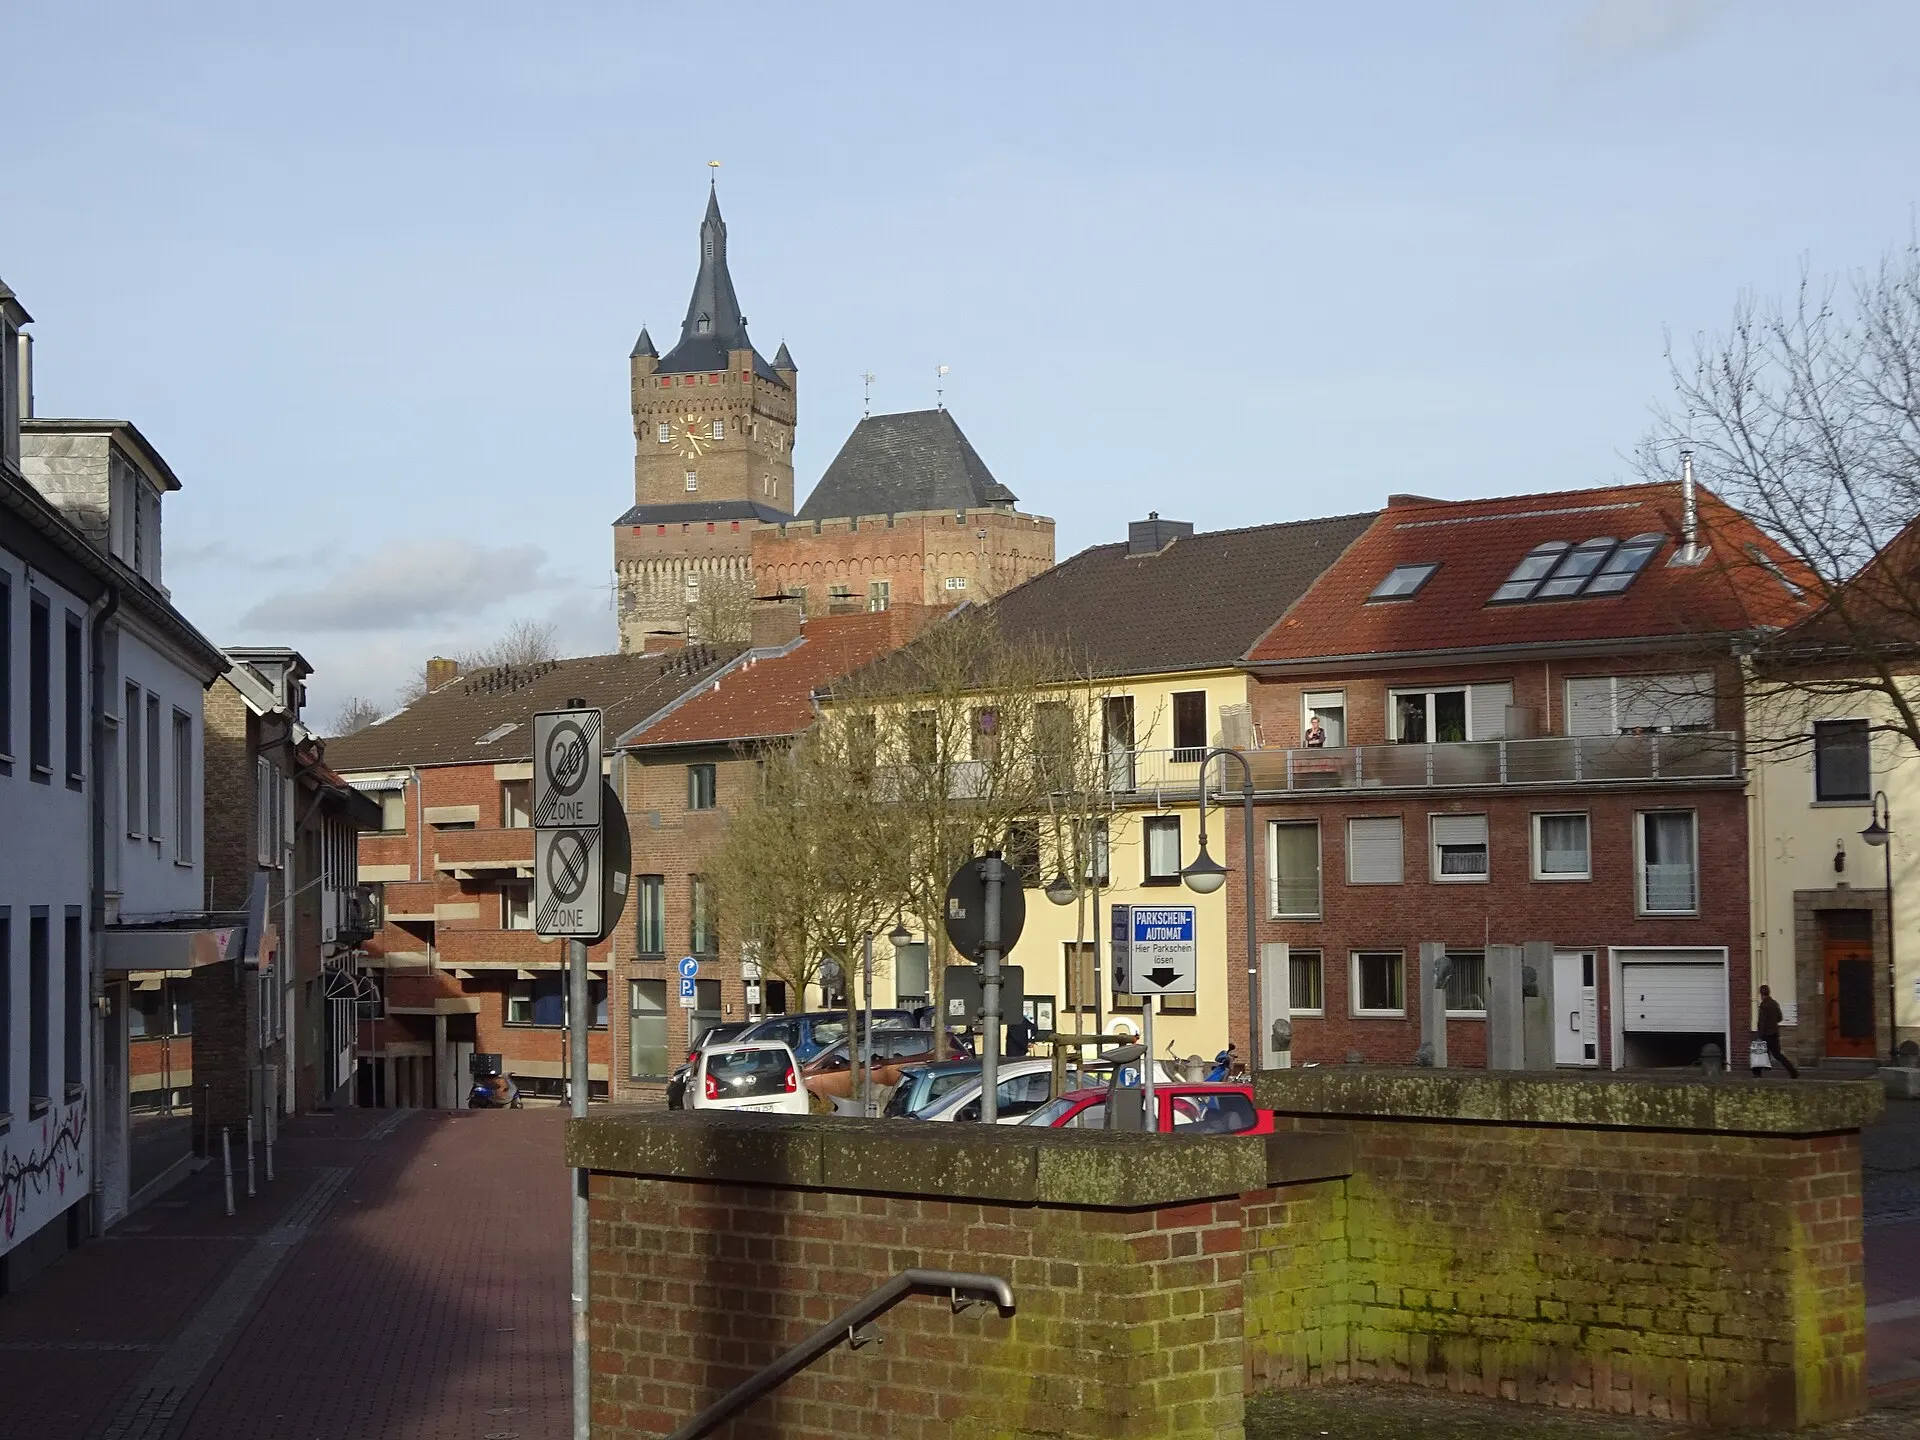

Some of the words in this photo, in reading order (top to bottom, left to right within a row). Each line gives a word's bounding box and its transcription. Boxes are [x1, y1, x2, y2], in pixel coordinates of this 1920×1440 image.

[551, 802, 584, 820] ZONE
[551, 909, 584, 927] ZONE
[1136, 912, 1190, 925] PARKSCHEIN-
[1146, 927, 1182, 940] AUTOMAT
[1135, 944, 1150, 953] Hier
[1153, 944, 1192, 953] Parkschein
[682, 980, 690, 995] P
